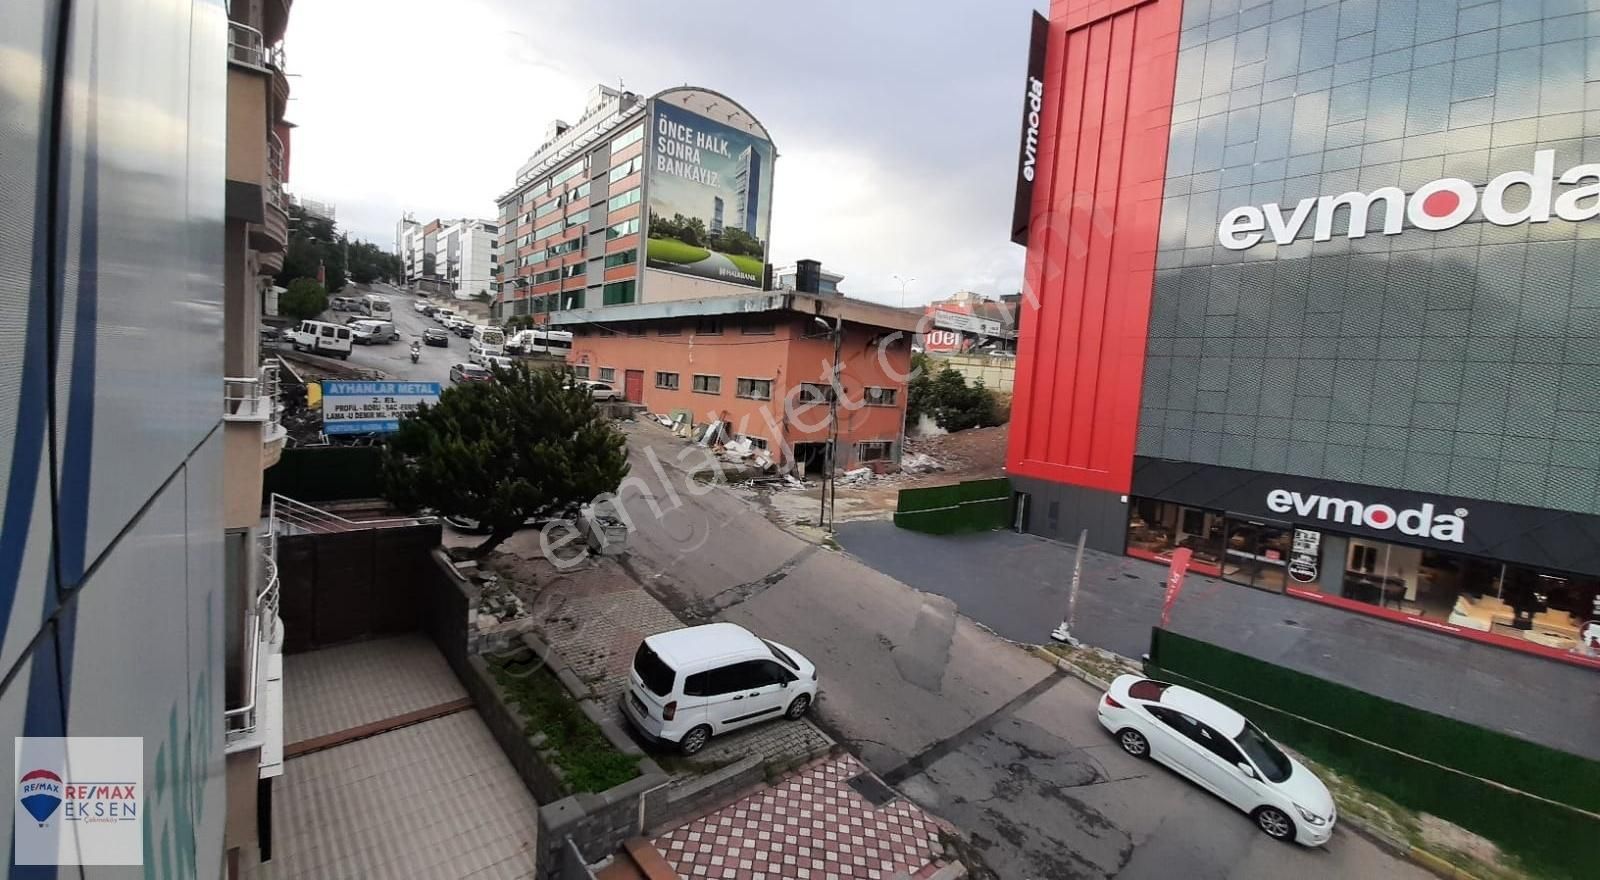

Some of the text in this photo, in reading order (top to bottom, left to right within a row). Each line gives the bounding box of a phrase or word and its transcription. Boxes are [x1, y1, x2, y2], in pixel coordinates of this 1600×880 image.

[659, 113, 731, 158] ÖNCE HALK,
[657, 137, 701, 165] SONRA
[330, 383, 435, 394] AYHANLAR METAL
